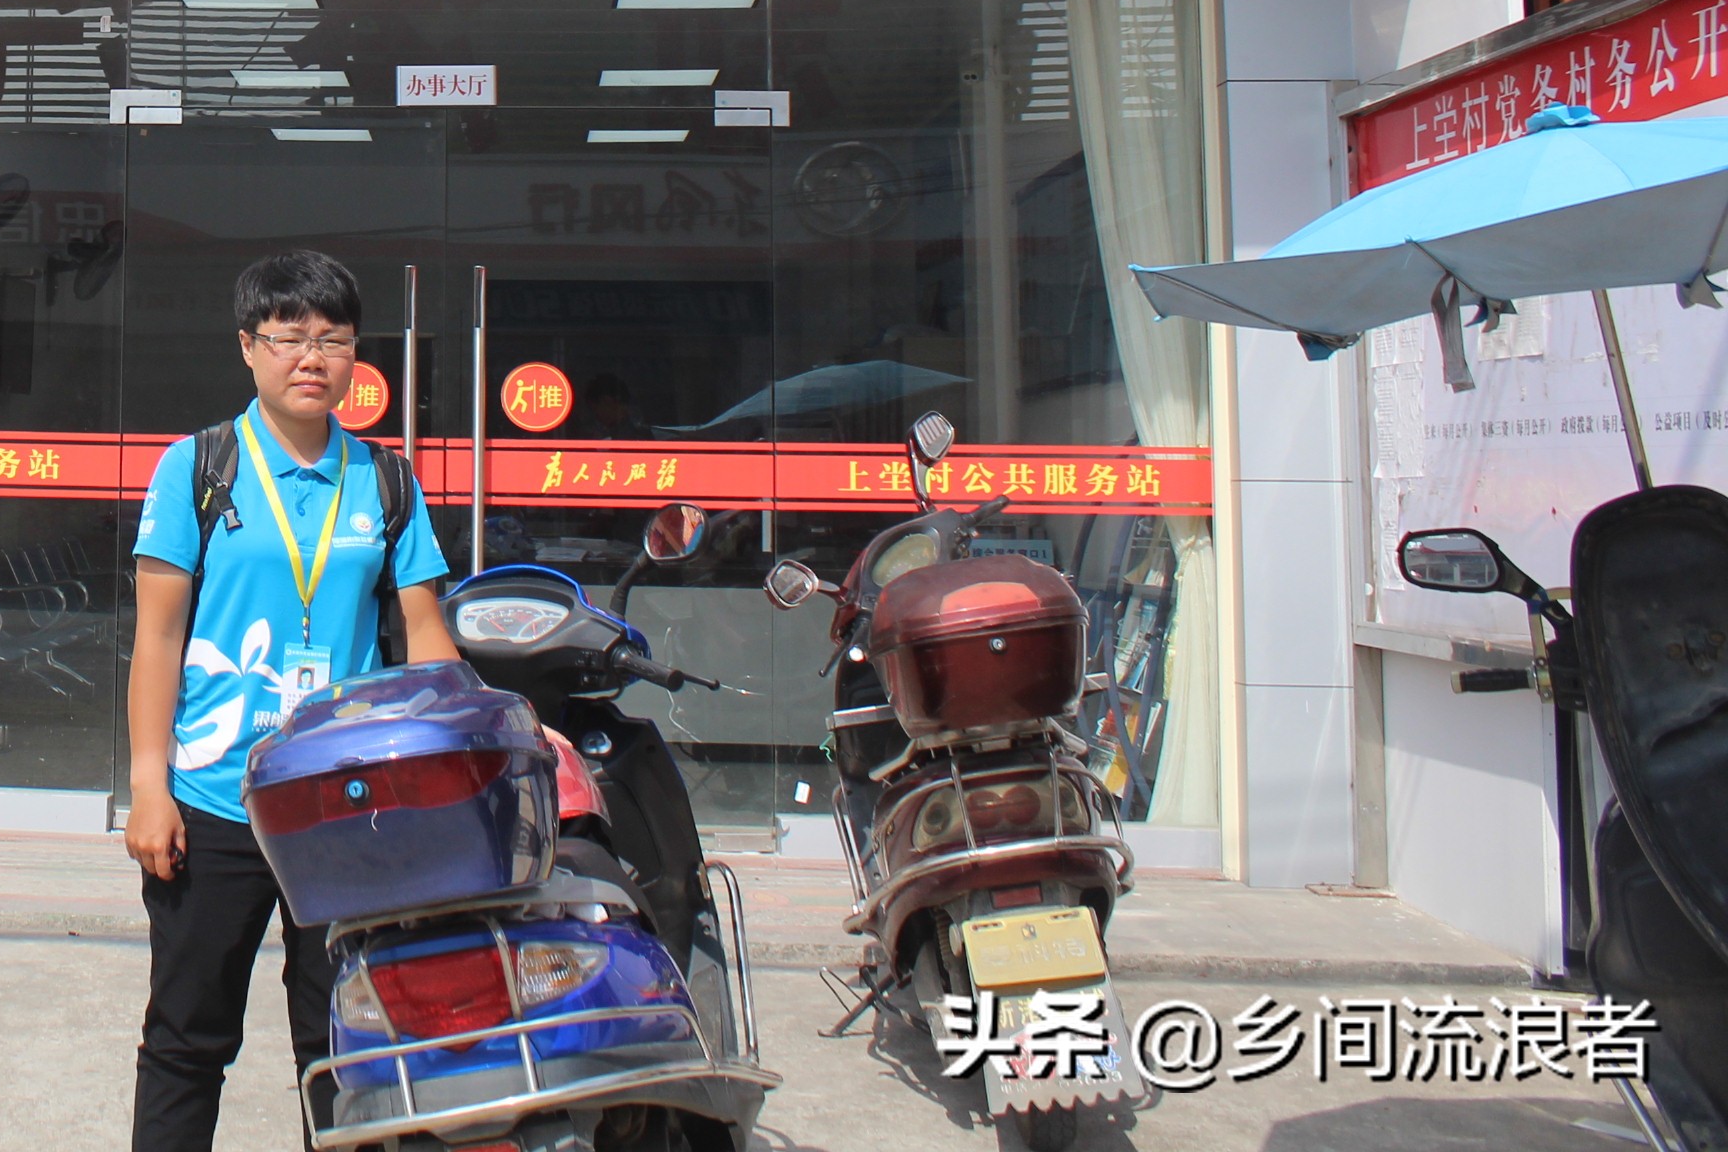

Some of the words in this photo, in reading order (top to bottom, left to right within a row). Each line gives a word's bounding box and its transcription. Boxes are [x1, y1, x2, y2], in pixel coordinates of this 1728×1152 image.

[406, 74, 487, 97] 办事大厅
[355, 384, 379, 408] 推
[538, 384, 563, 409] 推
